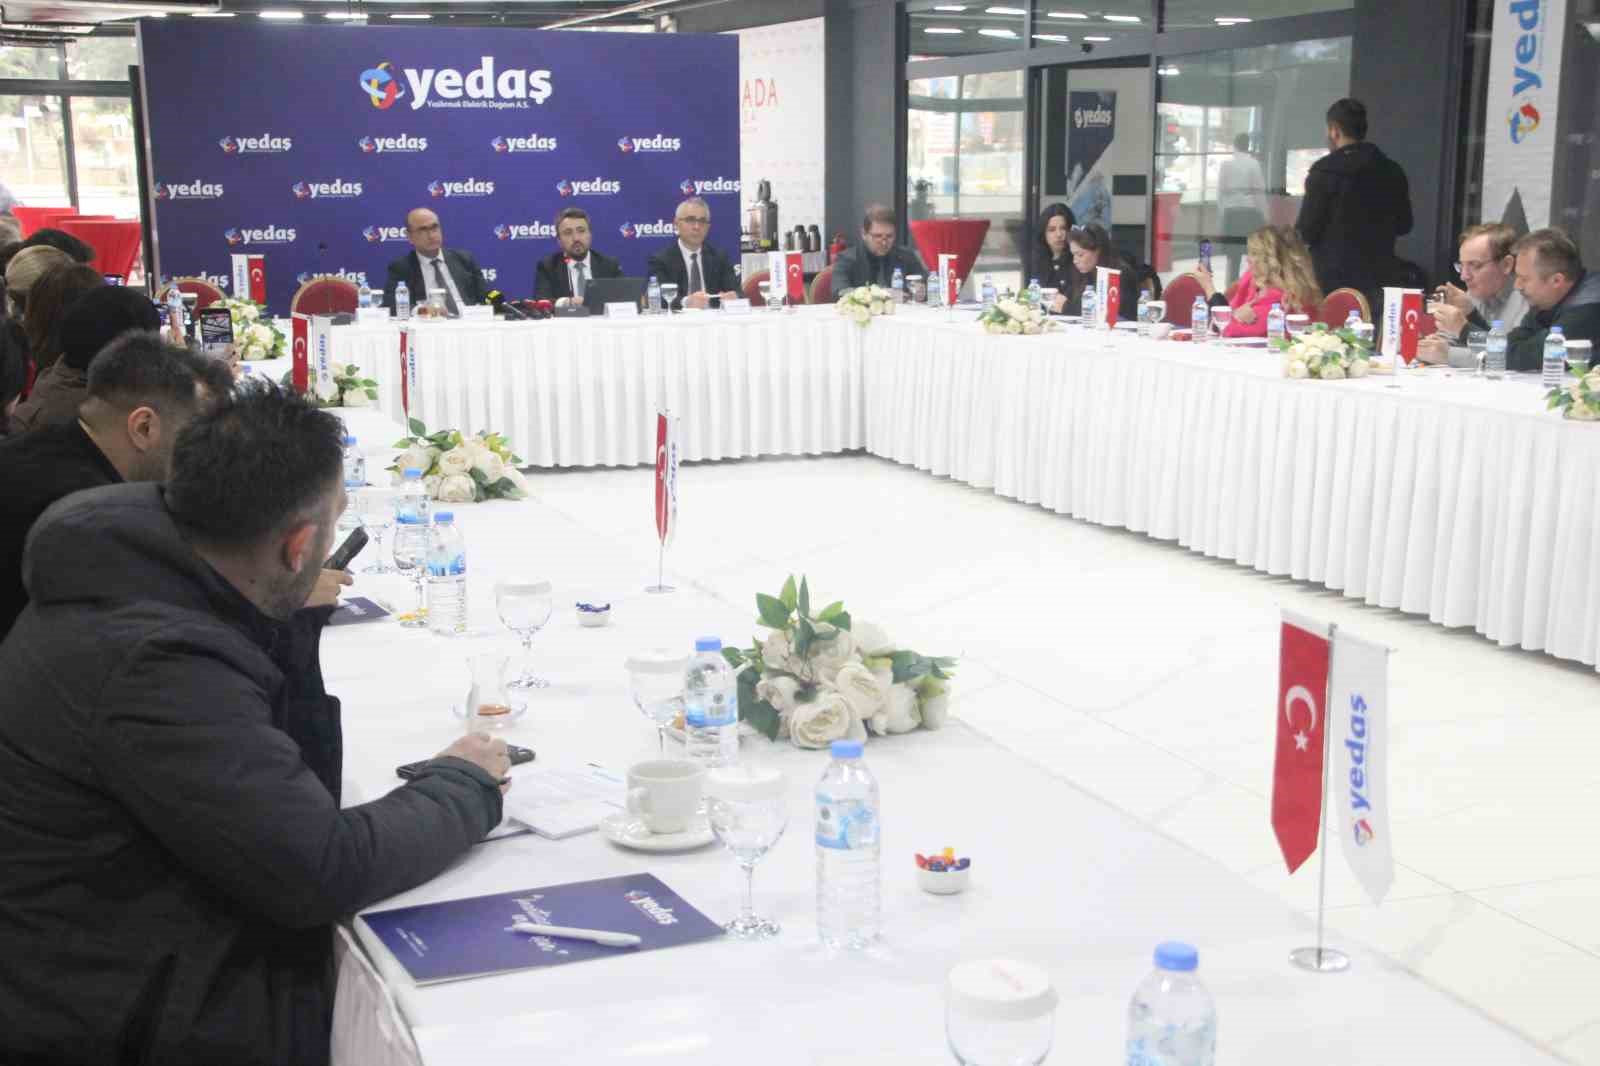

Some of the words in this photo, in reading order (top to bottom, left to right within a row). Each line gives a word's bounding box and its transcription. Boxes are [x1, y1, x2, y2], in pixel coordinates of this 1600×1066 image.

[402, 56, 553, 110] yedaş
[236, 133, 292, 153] yedaş
[374, 133, 428, 153] yedaş
[506, 133, 557, 153] yedaş
[632, 133, 681, 153] yedaş
[166, 179, 224, 201] yedaş
[308, 178, 363, 199] yedaş
[442, 177, 494, 197] yedaş
[570, 177, 621, 196] yedaş
[241, 224, 297, 245] yedaş
